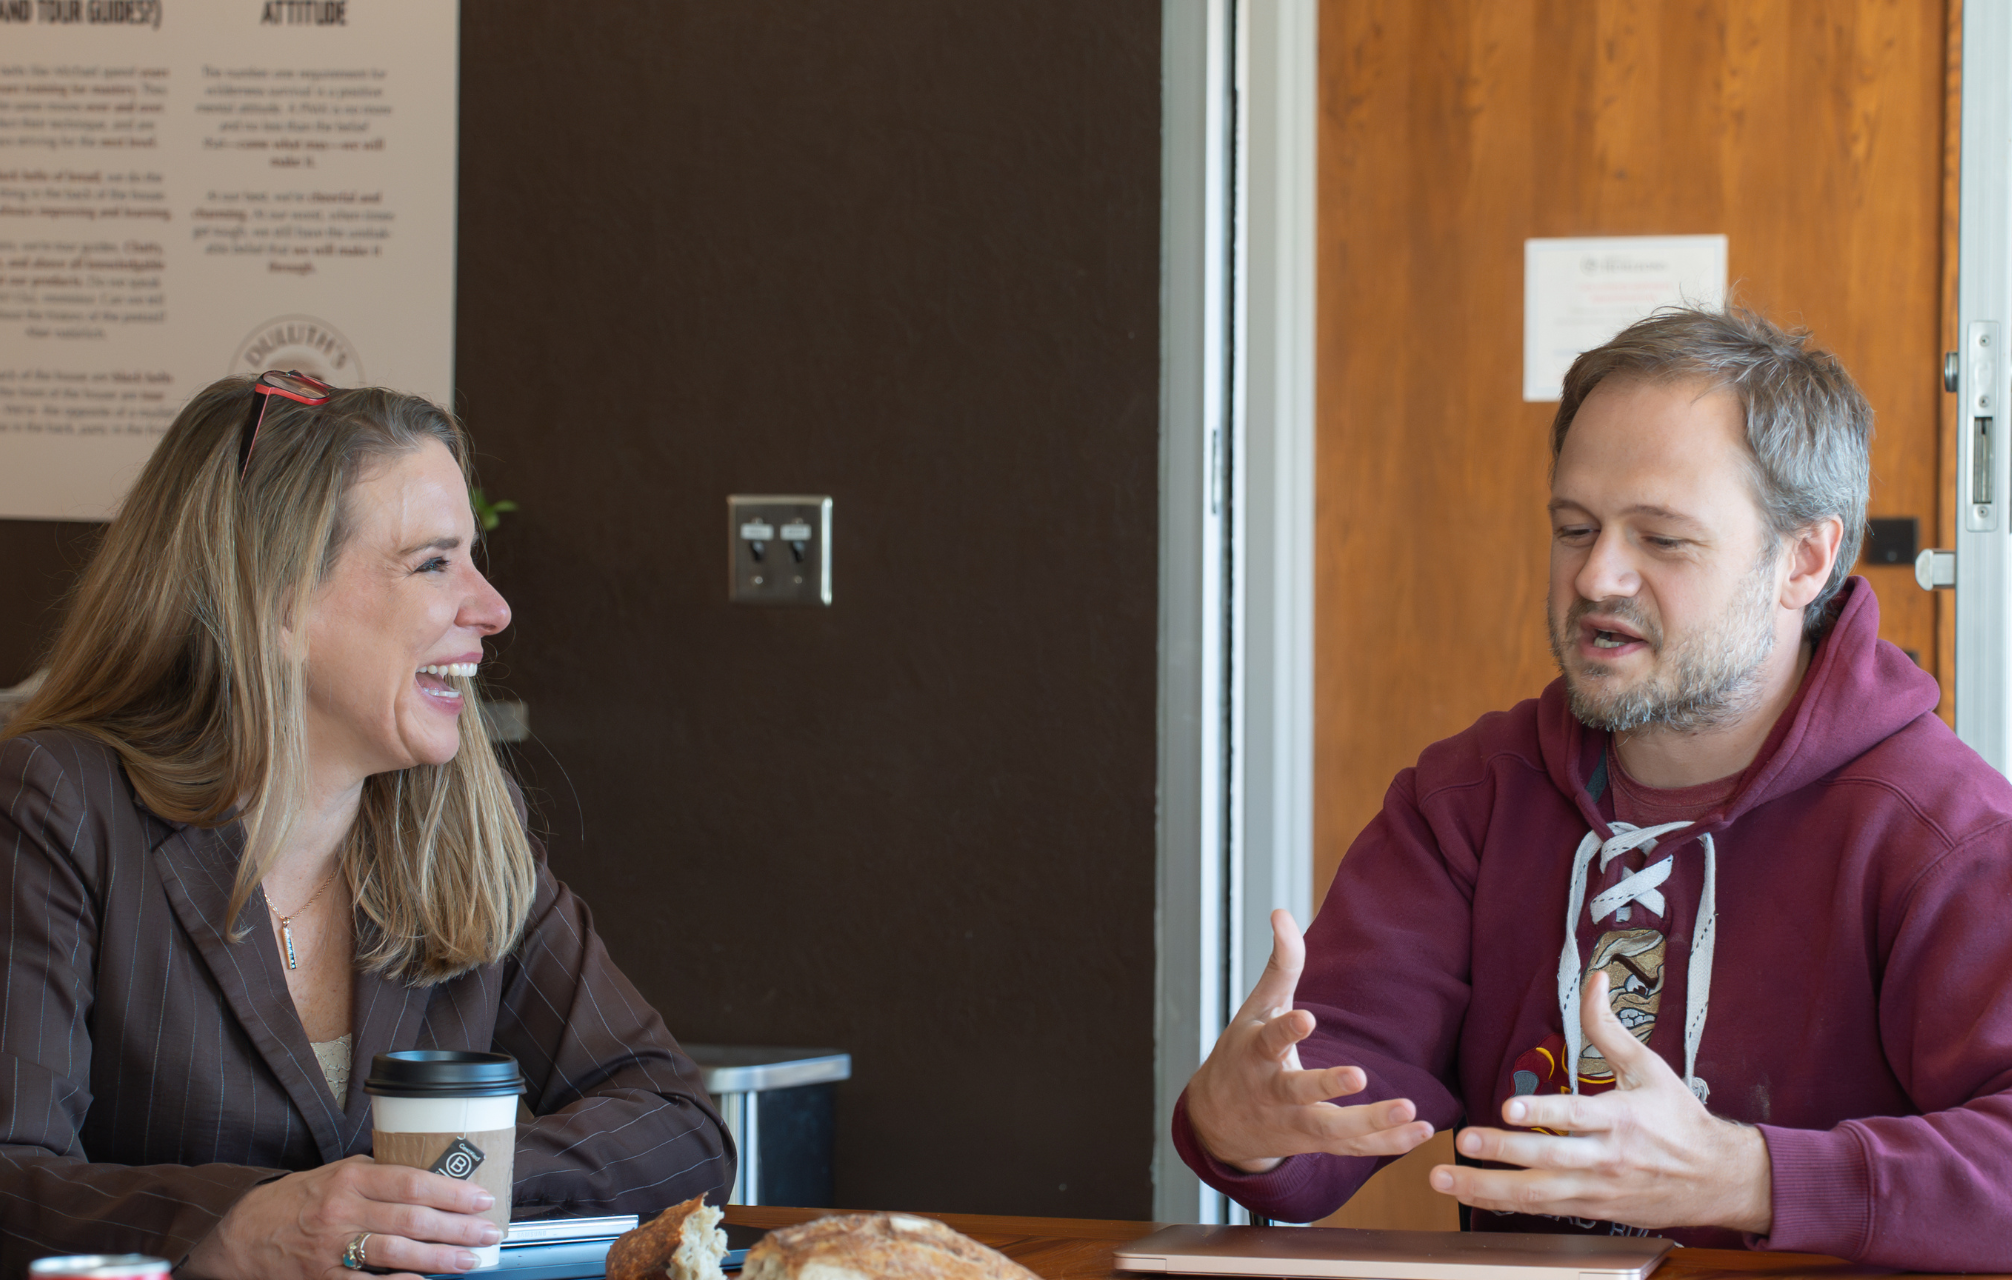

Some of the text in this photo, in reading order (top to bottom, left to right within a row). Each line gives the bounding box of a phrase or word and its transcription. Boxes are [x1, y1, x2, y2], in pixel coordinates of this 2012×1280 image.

[38, 0, 82, 24] TOUR
[261, 1, 348, 26] ATTITUDE
[146, 171, 163, 185] the
[45, 188, 61, 201] the
[110, 189, 127, 201] the
[101, 311, 119, 323] the
[244, 323, 347, 370] DULUTH'S
[34, 369, 51, 383] the
[63, 387, 80, 400] the
[449, 1155, 467, 1173] B
